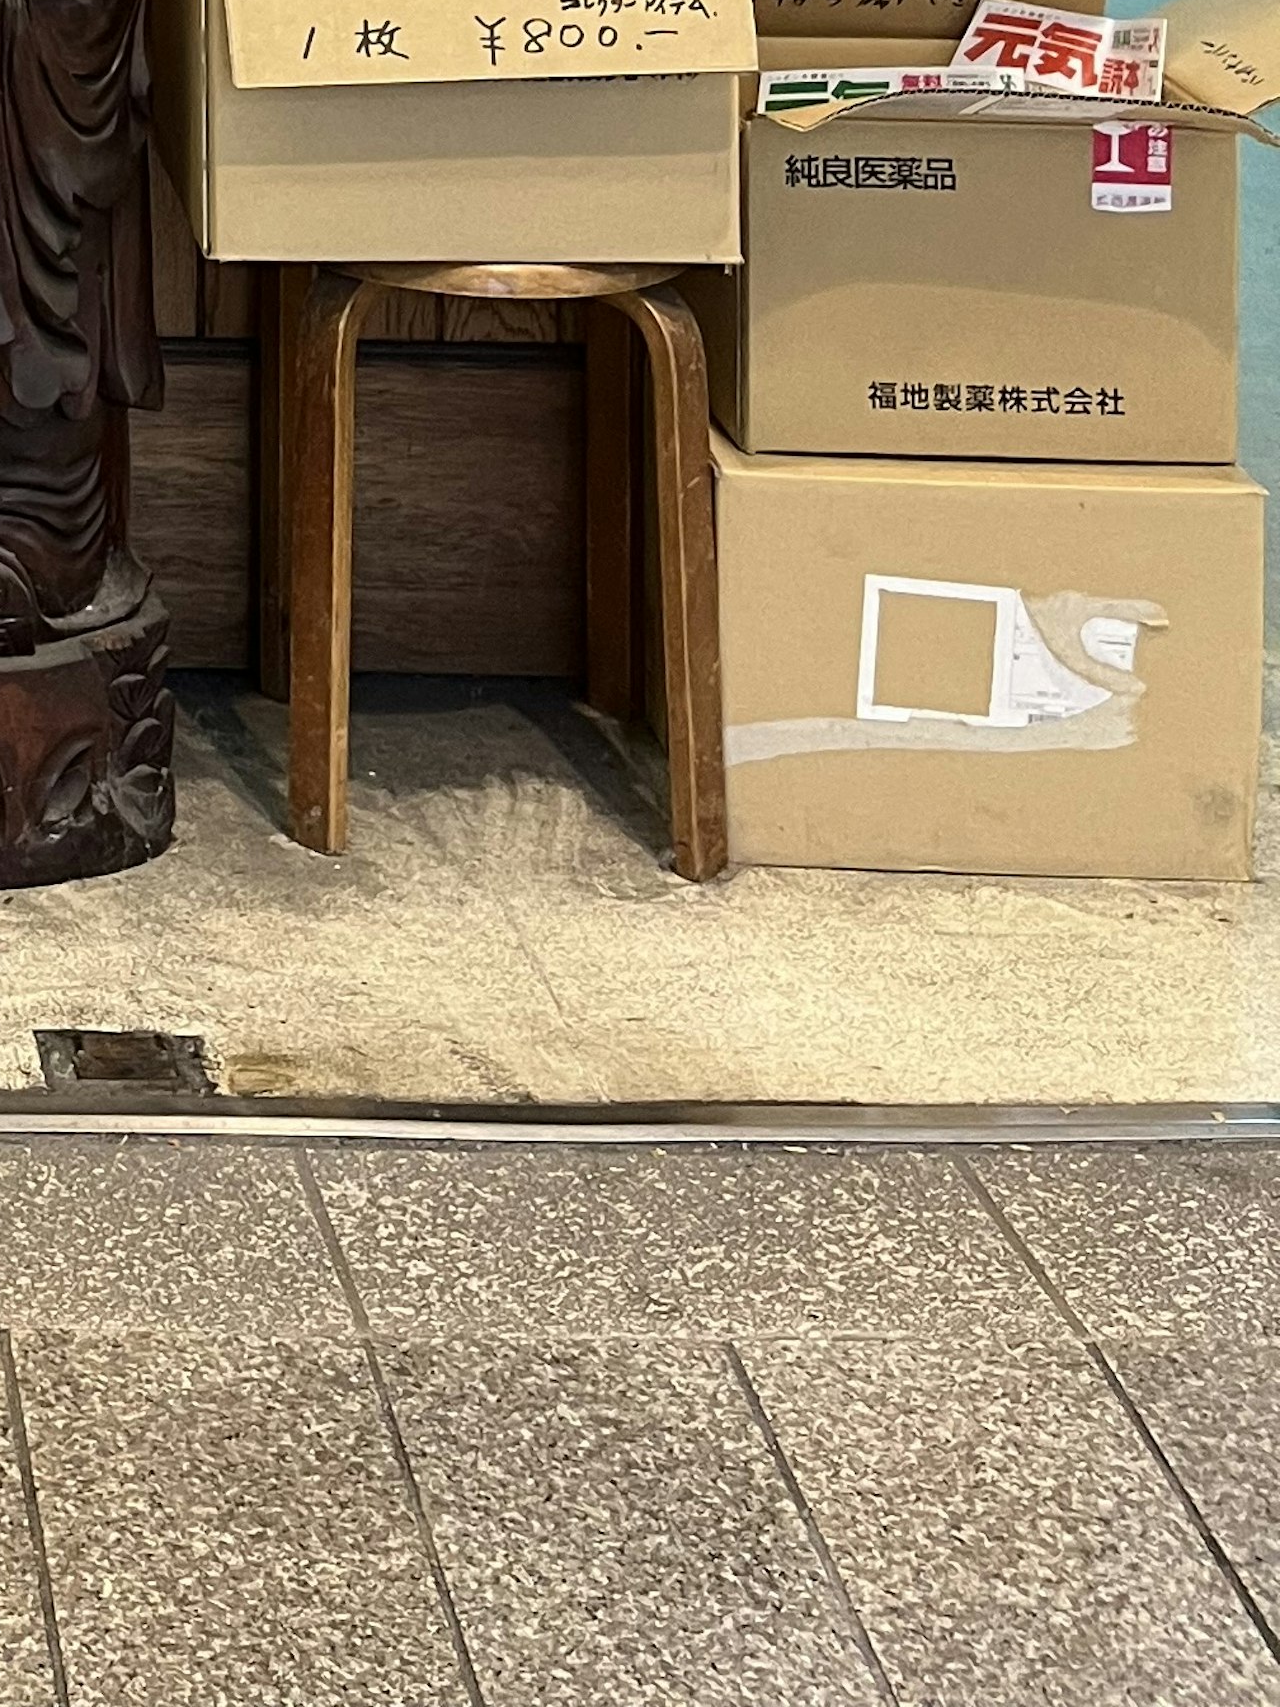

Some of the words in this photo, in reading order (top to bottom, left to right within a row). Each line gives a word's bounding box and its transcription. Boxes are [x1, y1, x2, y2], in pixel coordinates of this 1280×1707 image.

[962, 12, 1104, 90] 元気
[785, 154, 957, 191] 純良医薬品
[867, 380, 1126, 416] 福地製薬株式会社
